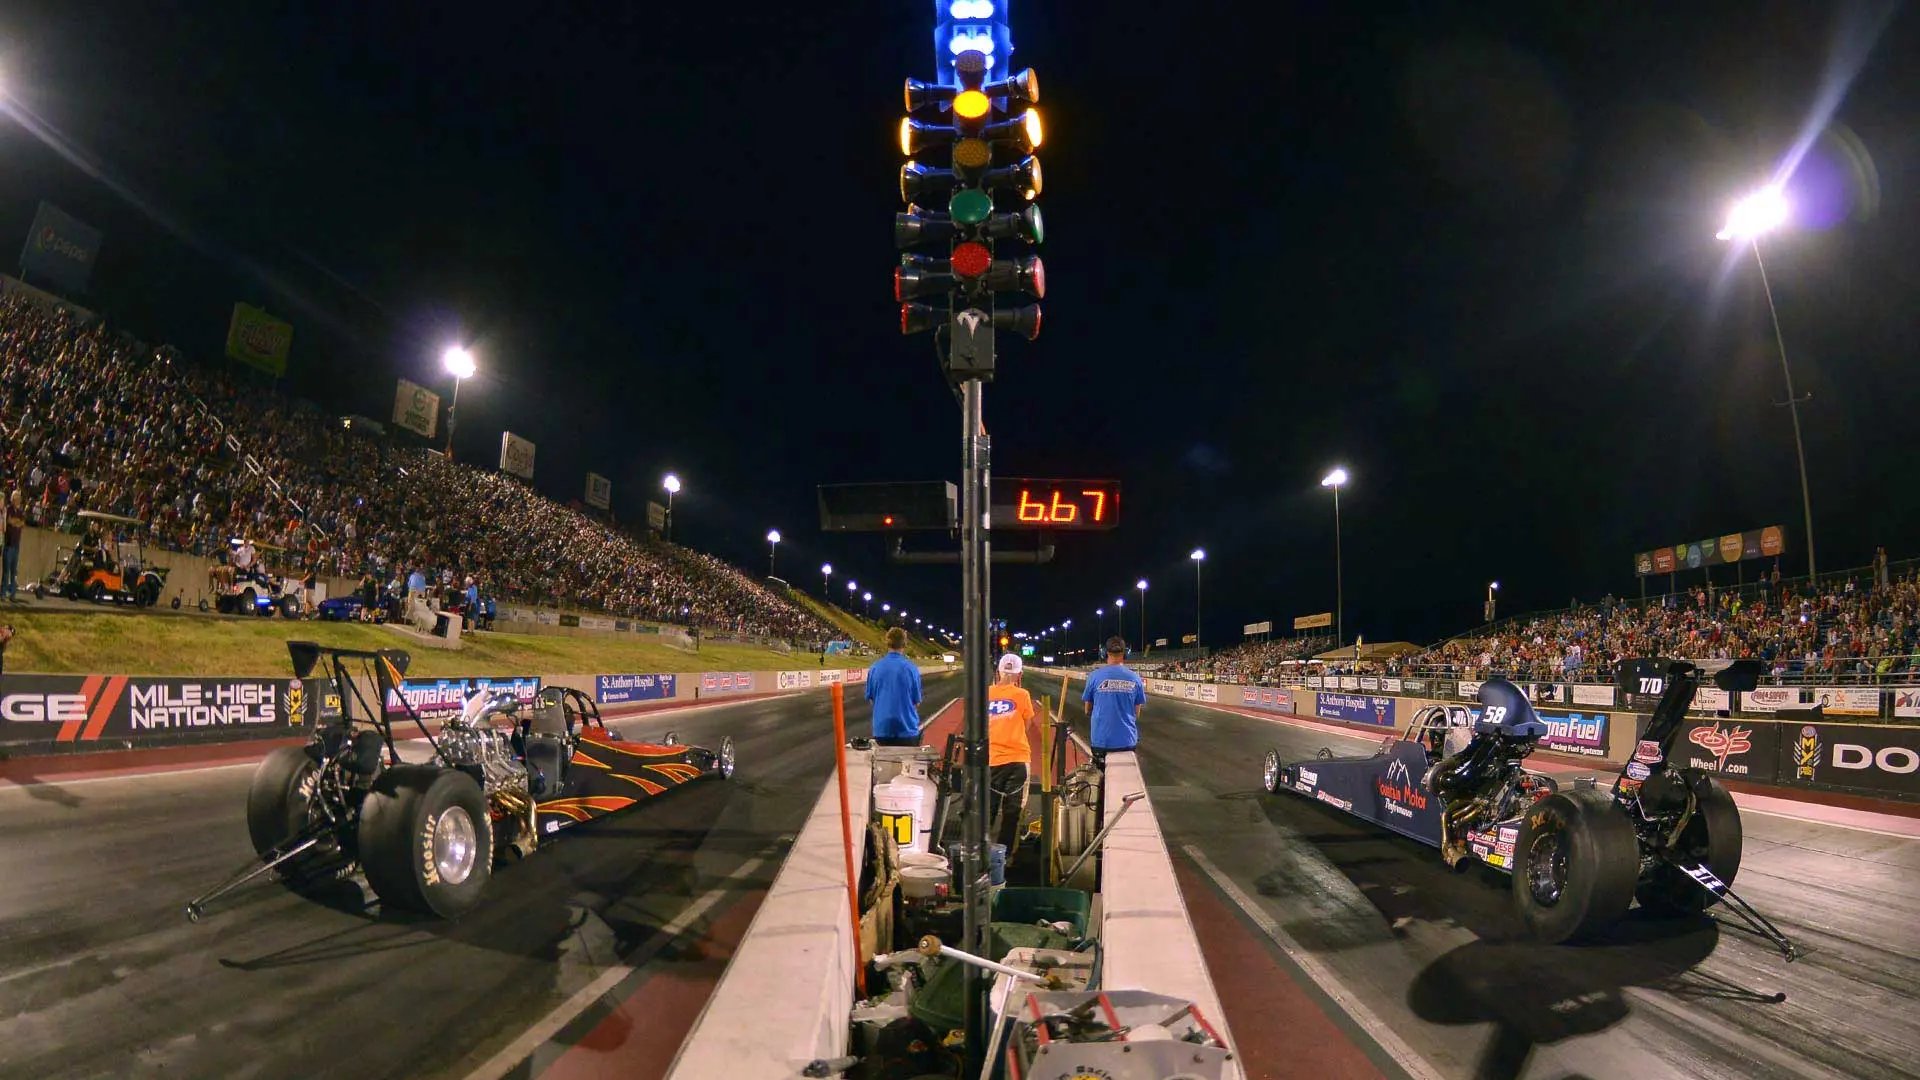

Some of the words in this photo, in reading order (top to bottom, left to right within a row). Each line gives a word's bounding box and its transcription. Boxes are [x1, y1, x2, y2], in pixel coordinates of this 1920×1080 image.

[1018, 490, 1105, 522] 6.67
[612, 676, 633, 691] Anthony
[634, 675, 654, 691] Hospital
[1327, 694, 1345, 710] Anthony
[1346, 696, 1366, 711] Hospital
[131, 704, 276, 729] NATIONALS
[1483, 706, 1506, 723] 58
[1550, 742, 1568, 752] Racing
[1580, 747, 1604, 756] Systems
[1690, 757, 1716, 771] Wheel
[1404, 785, 1427, 809] Motor
